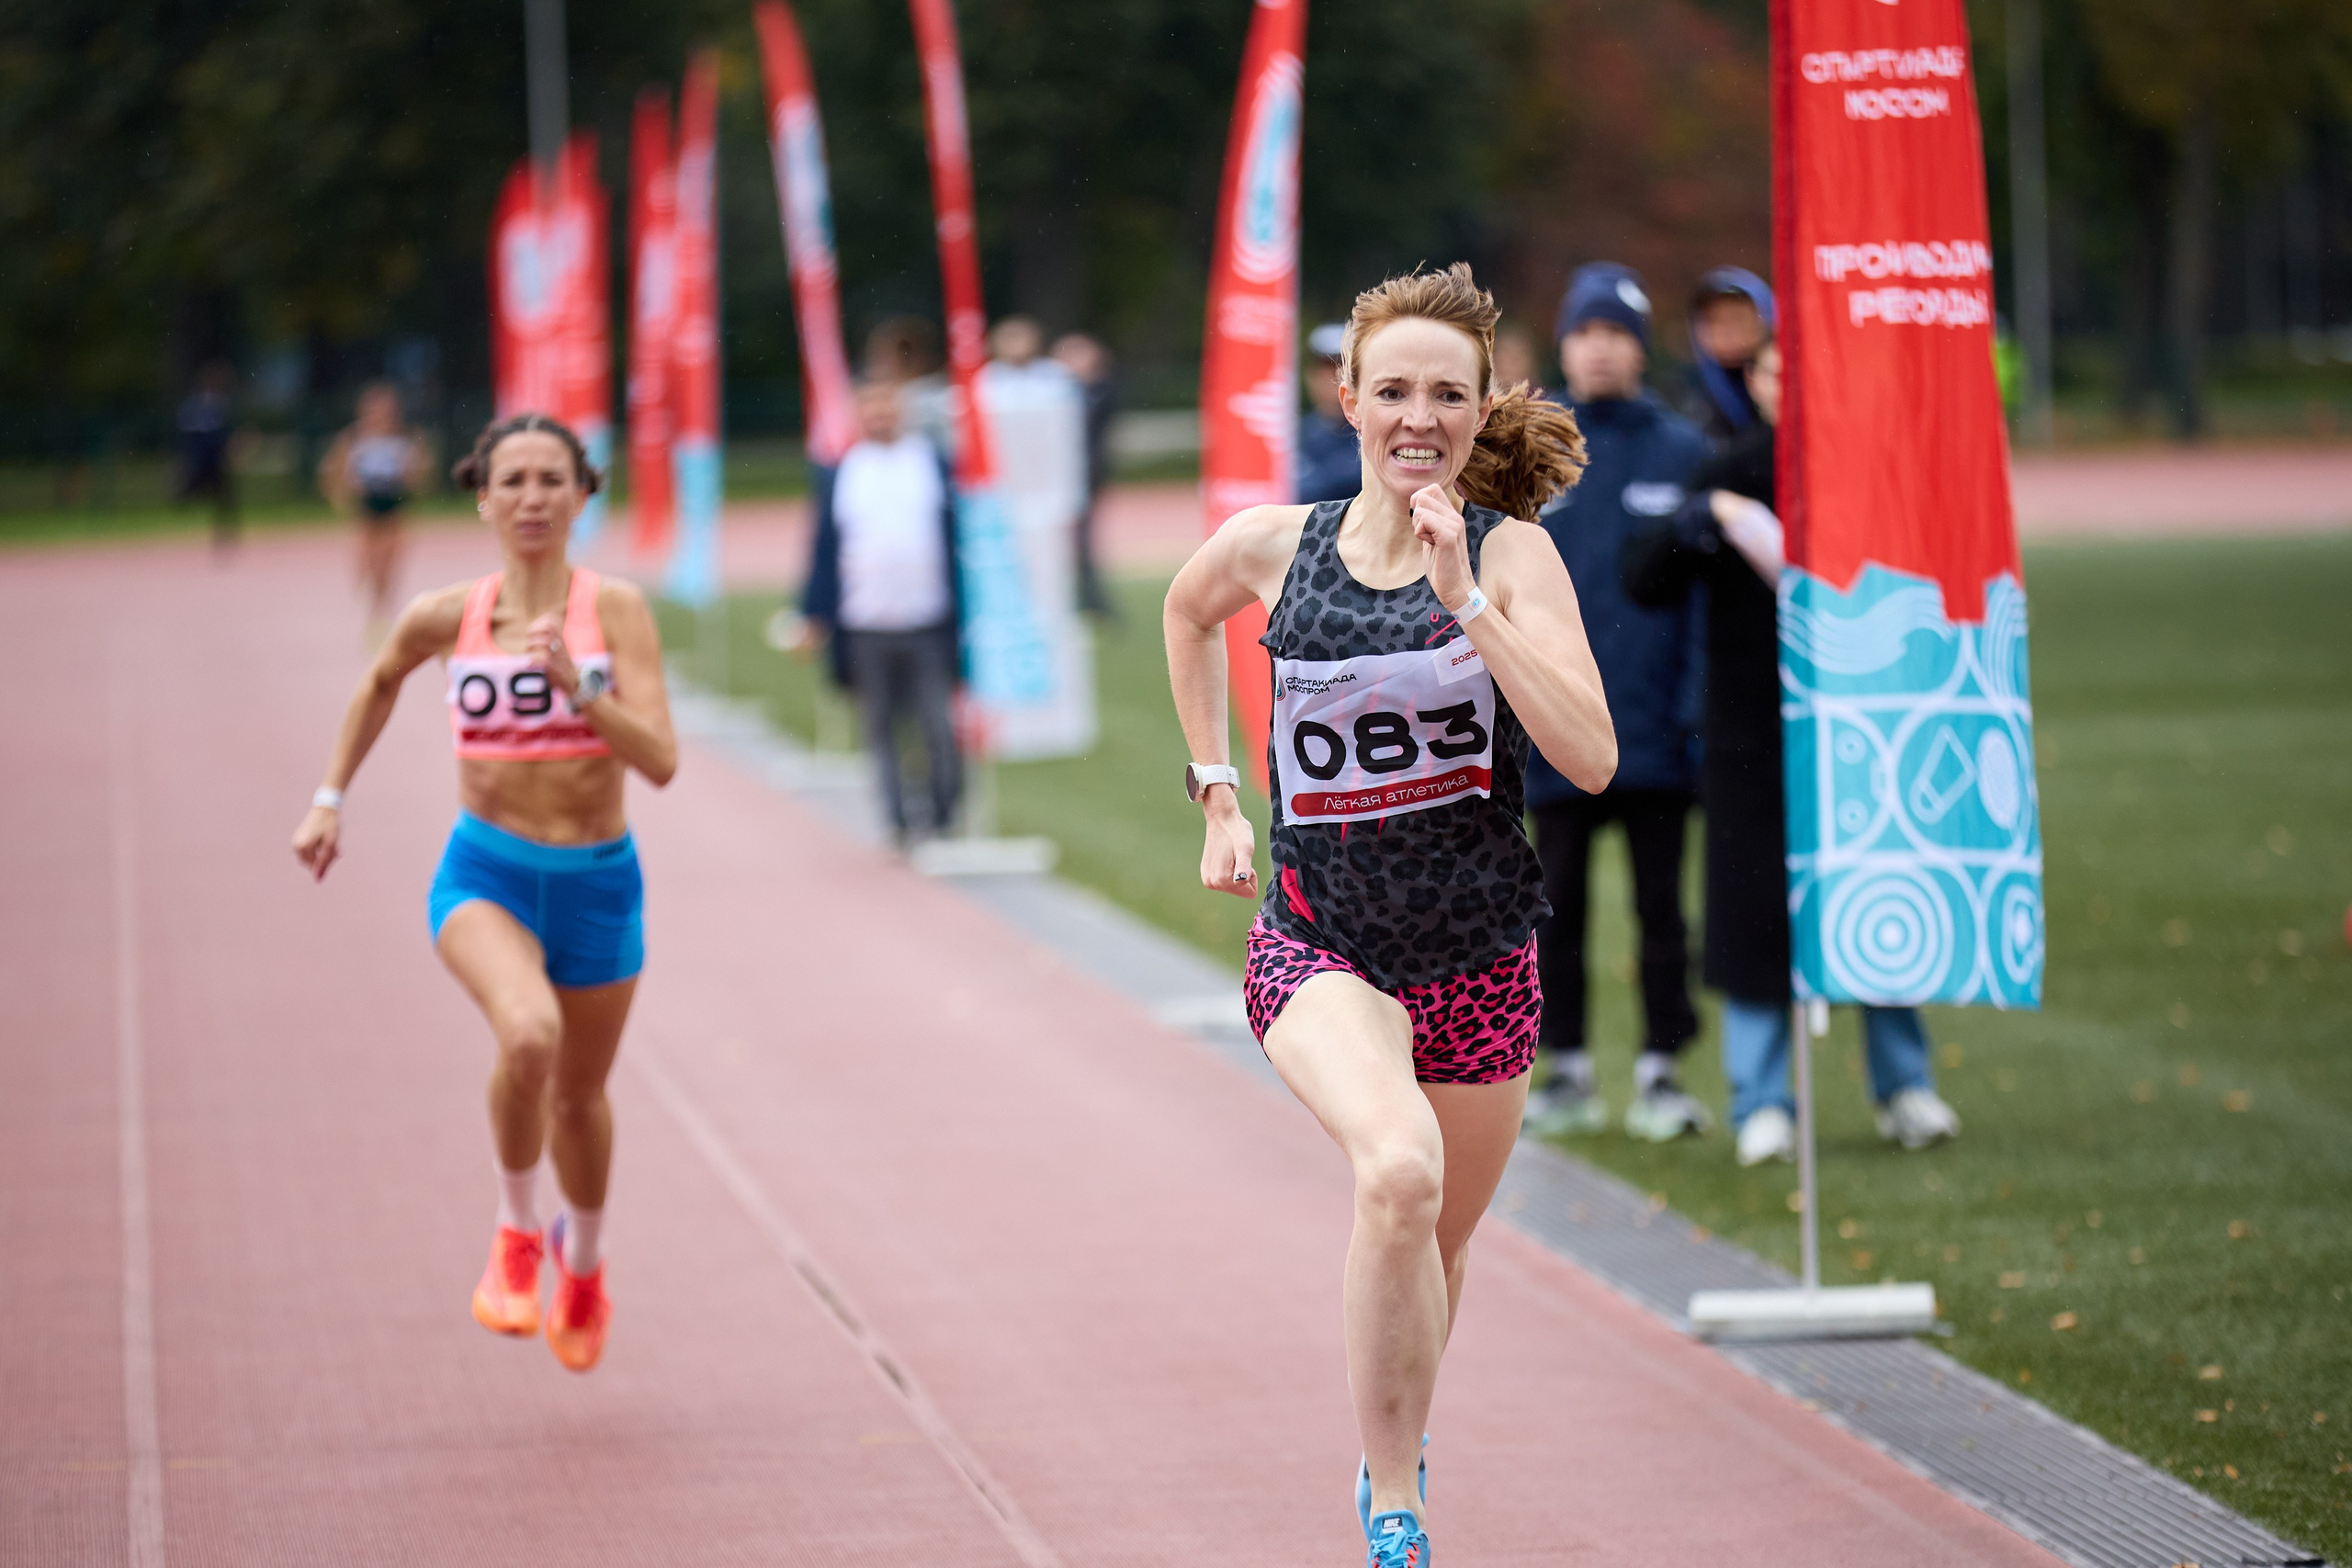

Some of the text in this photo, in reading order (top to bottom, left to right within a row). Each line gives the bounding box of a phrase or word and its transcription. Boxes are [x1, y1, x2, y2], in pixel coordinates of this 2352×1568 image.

[1451, 649, 1478, 667] 2025
[1285, 673, 1357, 688] СПАРТАКИАДА
[1287, 684, 1330, 695] МОСПРОМ
[1294, 699, 1488, 781] 083
[1324, 774, 1469, 810] Лёгкая атлетика
[1384, 1517, 1400, 1528] NIKE
